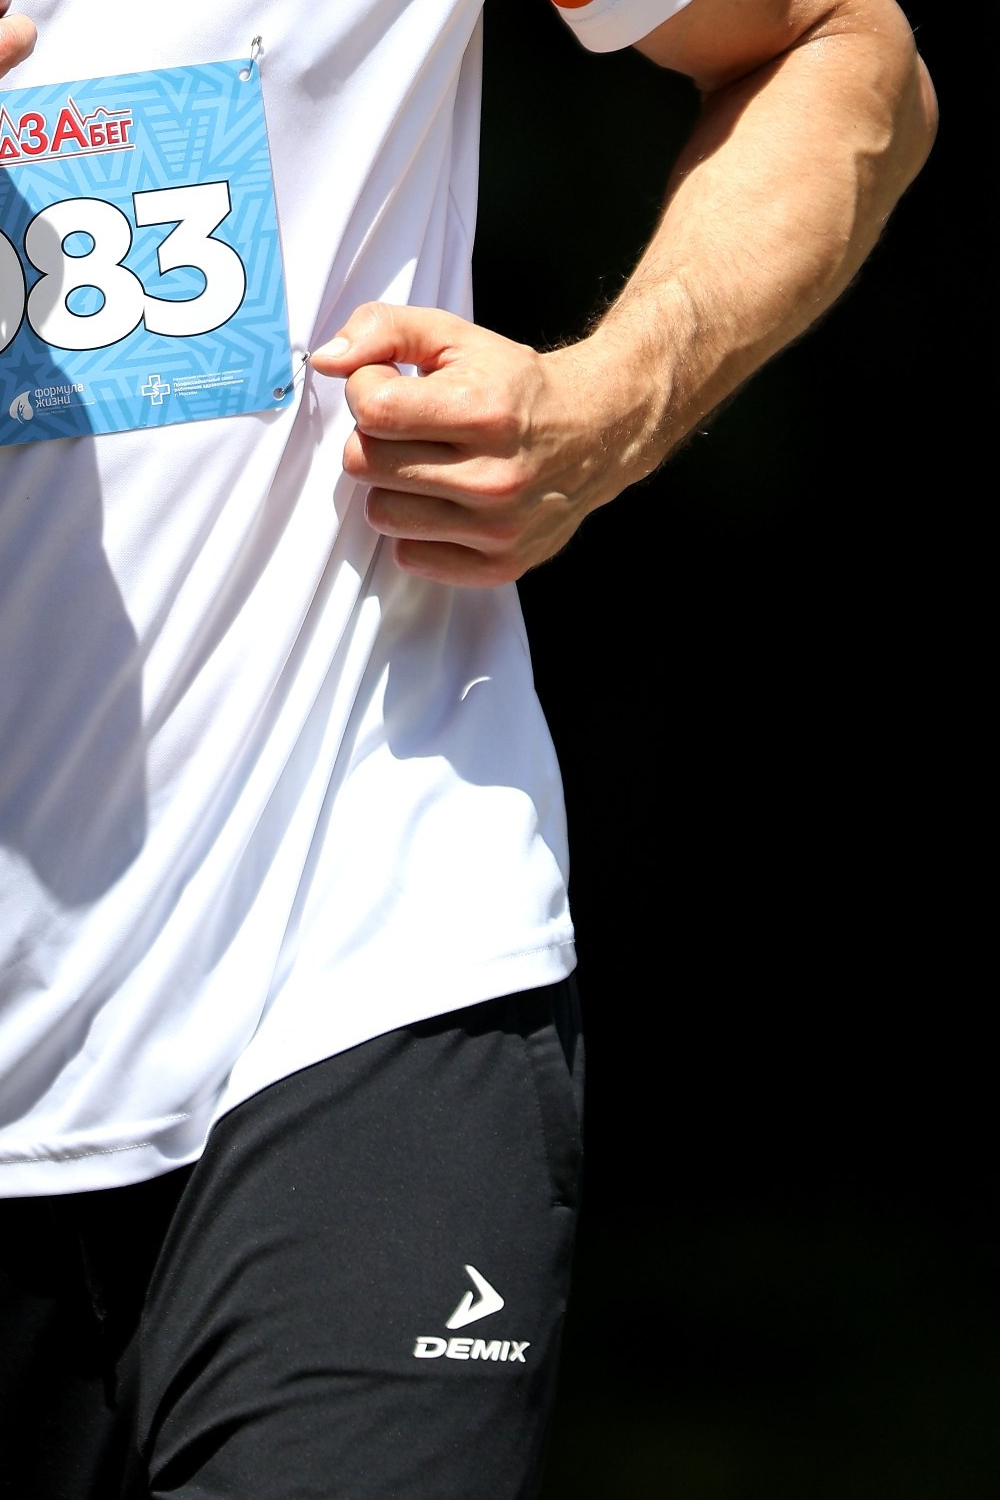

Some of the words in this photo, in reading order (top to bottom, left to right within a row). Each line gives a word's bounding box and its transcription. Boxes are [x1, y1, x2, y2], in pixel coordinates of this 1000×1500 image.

[34, 383, 84, 398] формула
[35, 395, 71, 408] жизни
[413, 1336, 531, 1363] DEMIX
